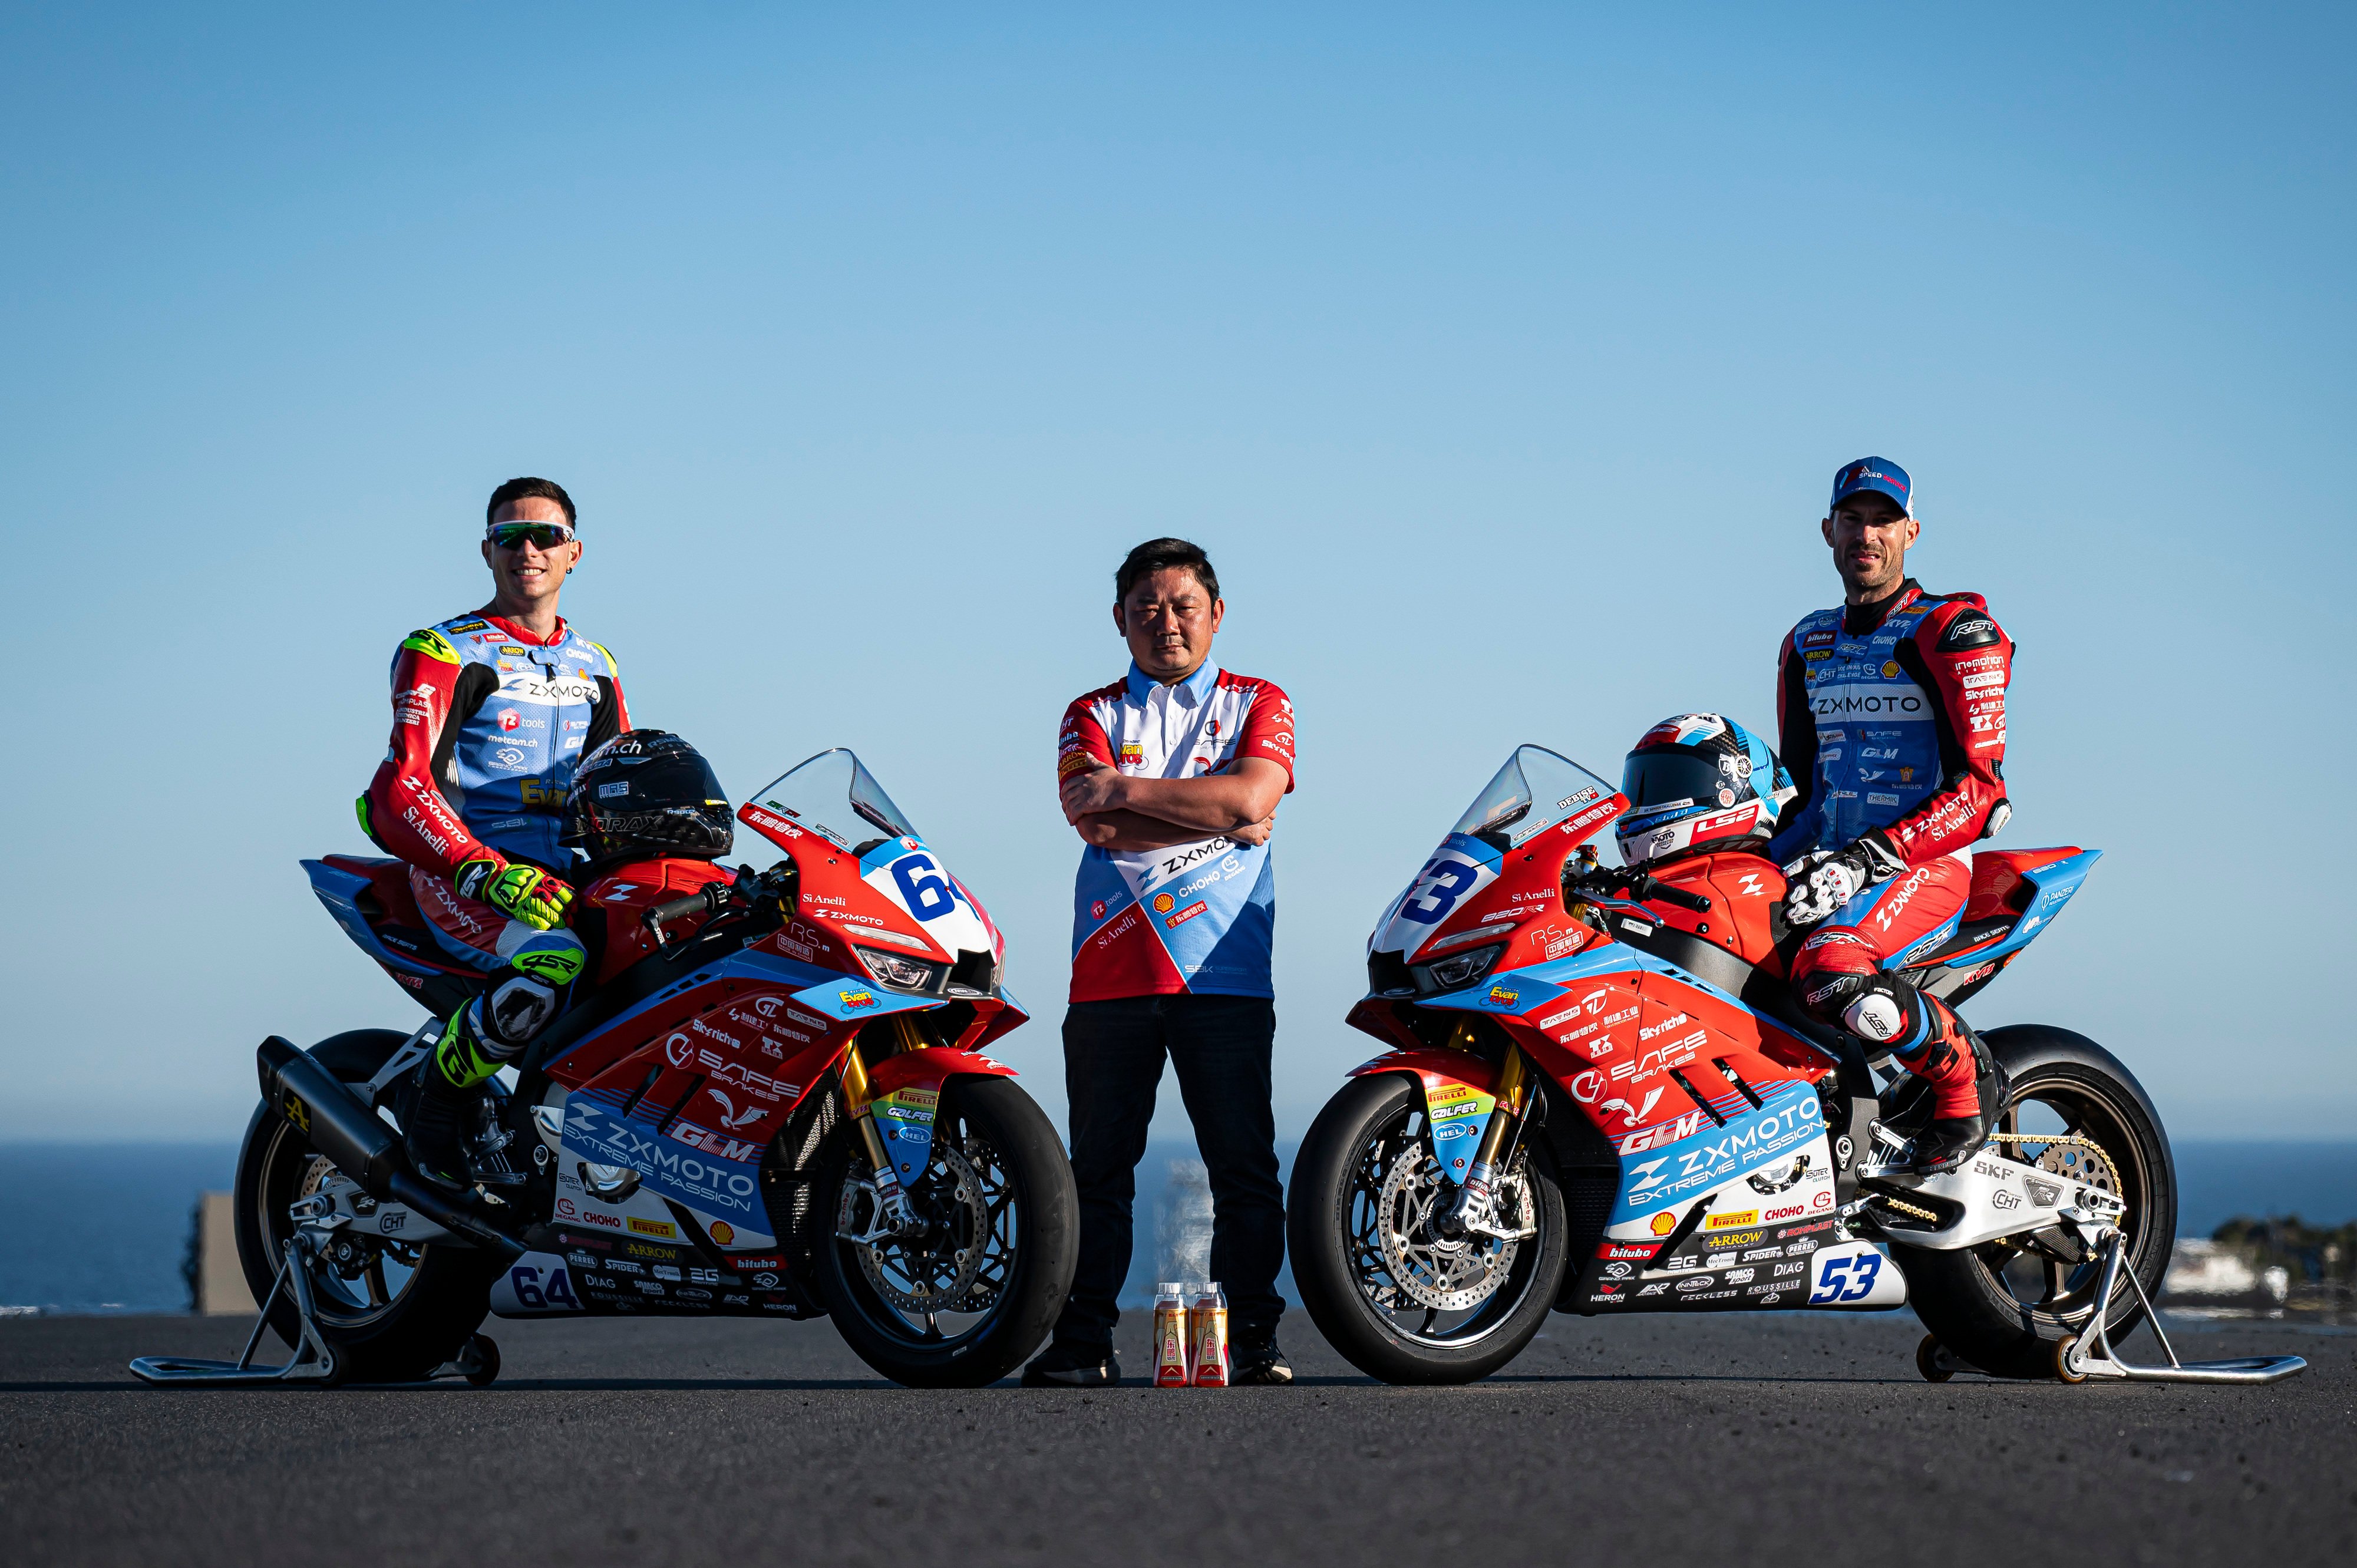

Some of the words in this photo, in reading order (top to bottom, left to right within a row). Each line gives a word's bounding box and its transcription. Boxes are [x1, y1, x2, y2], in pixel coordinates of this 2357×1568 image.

[1858, 471, 1883, 479] SPEED
[1883, 474, 1907, 493] SERVICE
[1886, 593, 1910, 621] RST
[1807, 633, 1833, 643] bitubo
[1950, 620, 1995, 641] RST
[1872, 635, 1897, 646] CHOHO
[503, 646, 524, 655] ARROW
[1805, 651, 1831, 659] ARROW
[1818, 668, 1837, 682] CHT
[529, 682, 599, 701] ZXMOTO
[1817, 696, 1922, 715] ZXMOTO
[521, 718, 546, 729] tools
[488, 735, 539, 748] metcam.ch
[1121, 744, 1143, 755] van
[1861, 747, 1899, 759] GLM
[1558, 786, 1595, 810] DEBISE
[1868, 793, 1898, 804] THERMIK
[416, 790, 468, 844] ZXMOTO
[1560, 802, 1618, 834] 东鹏特饮
[1916, 791, 1969, 832] ZXMOTO
[1945, 803, 1978, 836] Anelli
[748, 810, 803, 840] 东鹏特饮
[1696, 807, 1755, 834] LS2
[412, 817, 450, 856] Anelli
[1650, 831, 1675, 843] MOTO
[1163, 836, 1227, 875] ZXMO
[1224, 864, 1246, 882] DEGANG
[1178, 870, 1221, 898] CHOHO
[1888, 867, 1930, 917] ZXMOTO
[815, 894, 846, 906] Anelli
[1105, 890, 1123, 907] tools
[1523, 888, 1555, 901] Anelli
[2049, 884, 2075, 901] PANZERI
[435, 885, 482, 934] ZXMOTO
[830, 911, 884, 926] ZXMOTO
[1108, 914, 1137, 944] Anelli
[382, 933, 397, 943] RACE
[1548, 934, 1580, 953] 中国制造
[1974, 932, 1991, 943] RACE
[1549, 950, 1562, 959] MADE
[1568, 942, 1582, 951] CHINA
[521, 955, 579, 974] 4SR
[1184, 965, 1214, 973] SBK
[1963, 962, 1996, 986] KYB
[839, 991, 872, 1003] Evan
[1490, 986, 1520, 1001] Evan
[1807, 976, 1850, 1005] RST
[1874, 987, 1894, 997] FACTORY
[1610, 1029, 1708, 1082] SAFE
[698, 1048, 800, 1098] SAFE
[1630, 1051, 1696, 1084] BRAKES
[711, 1070, 780, 1102] BRAKES
[898, 1090, 936, 1105] PIRELLI
[1428, 1087, 1467, 1102] PIRELLI
[887, 1107, 934, 1122] GALFER
[1431, 1101, 1477, 1120] GALFER
[905, 1132, 926, 1141] HEL
[1439, 1128, 1461, 1138] HEL
[1619, 1111, 1701, 1156] GLM
[1679, 1096, 1819, 1177] ZXMOTO
[671, 1122, 755, 1163] GLM
[563, 1123, 654, 1177] EXTREME
[660, 1171, 751, 1212] PASSION
[606, 1122, 754, 1197] ZXMOTO
[1628, 1160, 1736, 1207] EXTREME
[1742, 1117, 1825, 1166] PASSION
[1806, 1167, 1828, 1179] SUTER
[1974, 1160, 2014, 1180] SKF
[559, 1173, 580, 1186] SUTER
[566, 1183, 582, 1192] CLUTCH
[1992, 1189, 2022, 1210] CHT
[840, 1192, 850, 1226] brembo
[1765, 1204, 1804, 1221] CHOHO
[1807, 1206, 1834, 1216] DEGANG
[379, 1211, 408, 1234] CHT
[555, 1213, 580, 1223] DEGANG
[583, 1212, 621, 1228] CHOHO
[1712, 1213, 1752, 1227] PIRELLI
[632, 1220, 669, 1236] PIRELLI
[1787, 1220, 1834, 1237] ROMPLAST
[1709, 1230, 1764, 1247] ARROW
[628, 1243, 677, 1259] ARROW
[1609, 1247, 1651, 1258] bitubo
[1714, 1243, 1754, 1251] EXHAUST
[1742, 1246, 1782, 1262] SPIDER
[1788, 1243, 1815, 1253] PERREL
[569, 1254, 596, 1265] PERREL
[605, 1259, 641, 1273] SPIDER
[737, 1259, 777, 1269] bitubo
[1667, 1255, 1698, 1269] 2G
[689, 1267, 719, 1282] 2G
[1725, 1267, 1755, 1280] SAMCO
[1774, 1262, 1804, 1277] DIAG
[584, 1273, 616, 1289] DIAG
[633, 1279, 663, 1289] SAMCO
[1731, 1275, 1752, 1283] sport
[1748, 1279, 1801, 1293] ROUSSILLE
[1808, 1254, 1882, 1305] 53
[511, 1266, 579, 1309] 64
[1590, 1293, 1625, 1302] HERON
[762, 1302, 797, 1312] HERON
